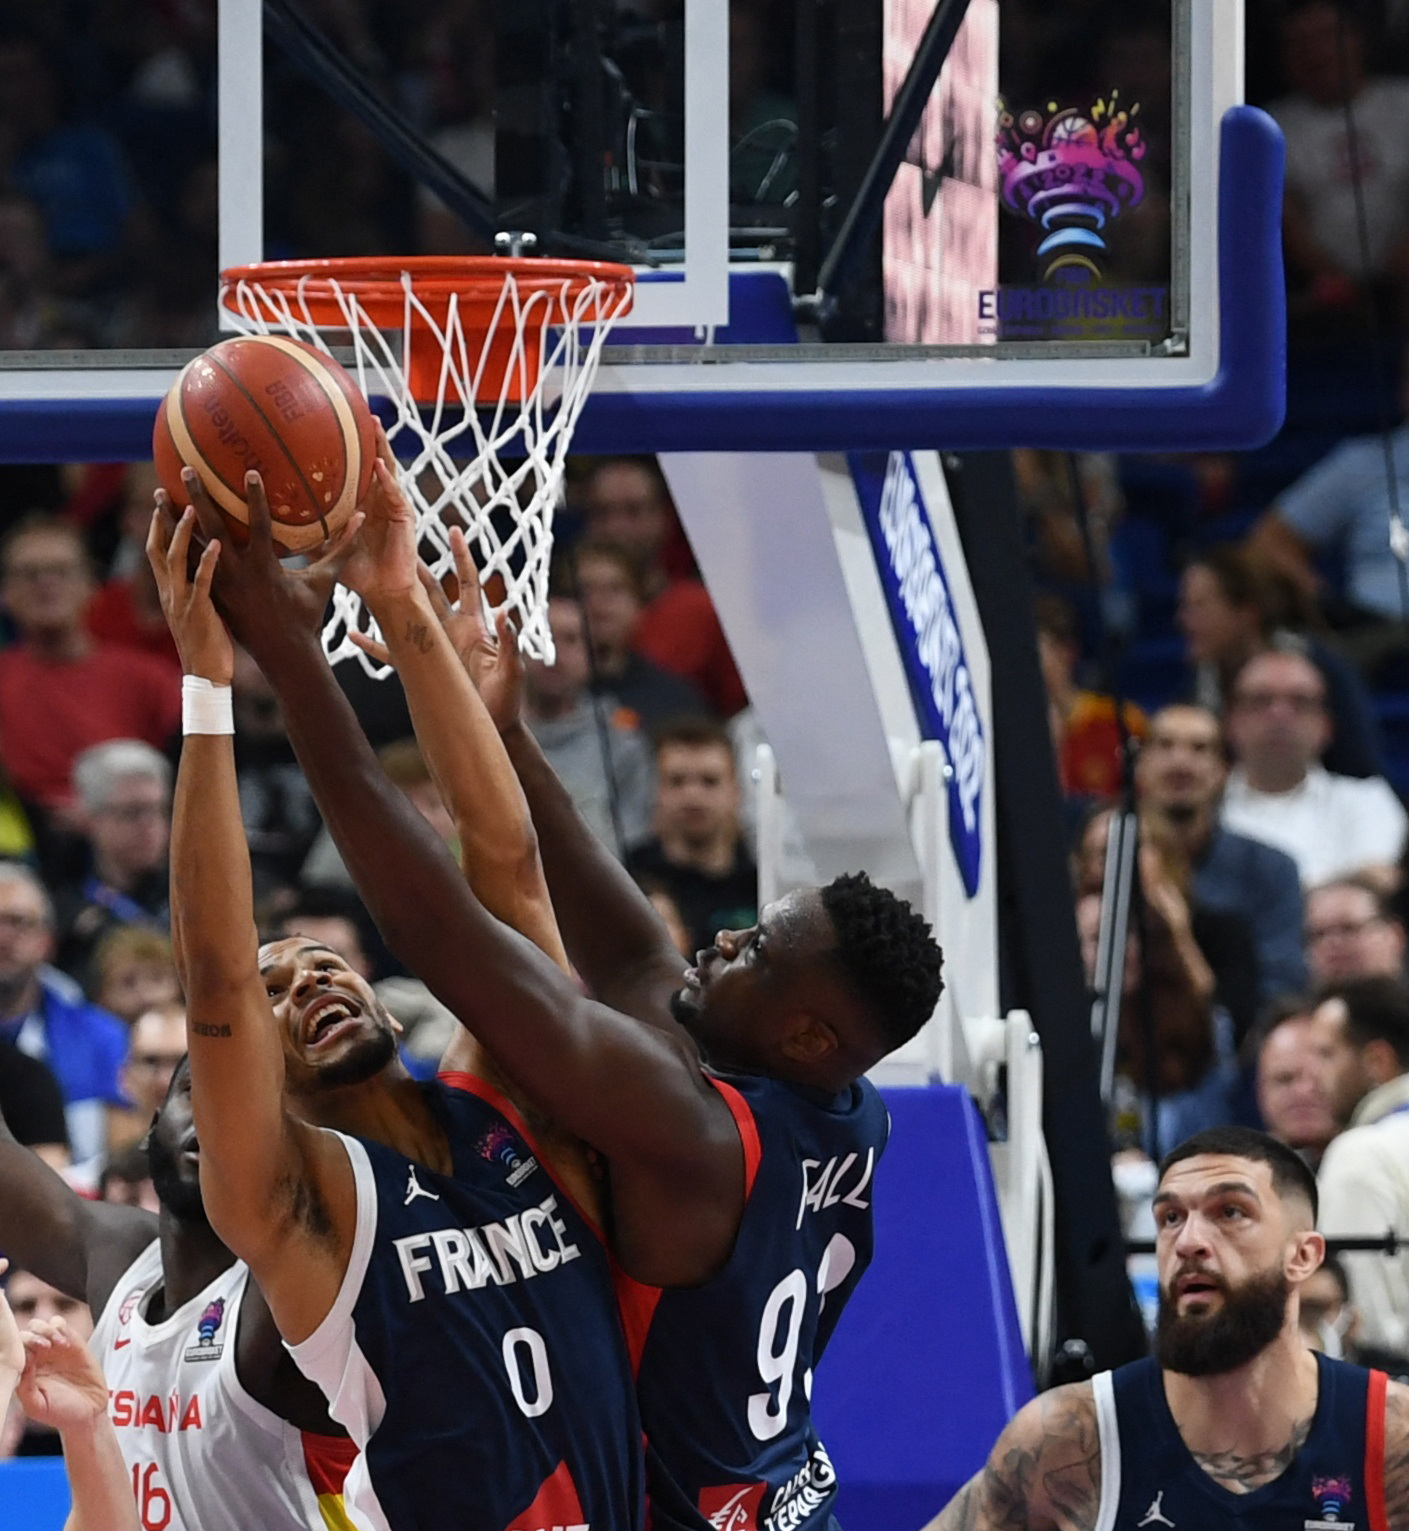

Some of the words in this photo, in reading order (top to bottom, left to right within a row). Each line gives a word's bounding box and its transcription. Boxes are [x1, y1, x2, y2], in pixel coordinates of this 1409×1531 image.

[977, 287, 1168, 321] EUROBASKET
[265, 380, 306, 426] FIBA
[795, 1146, 874, 1231] FALL
[392, 1193, 582, 1304] FRANCE
[502, 1326, 554, 1418] 0
